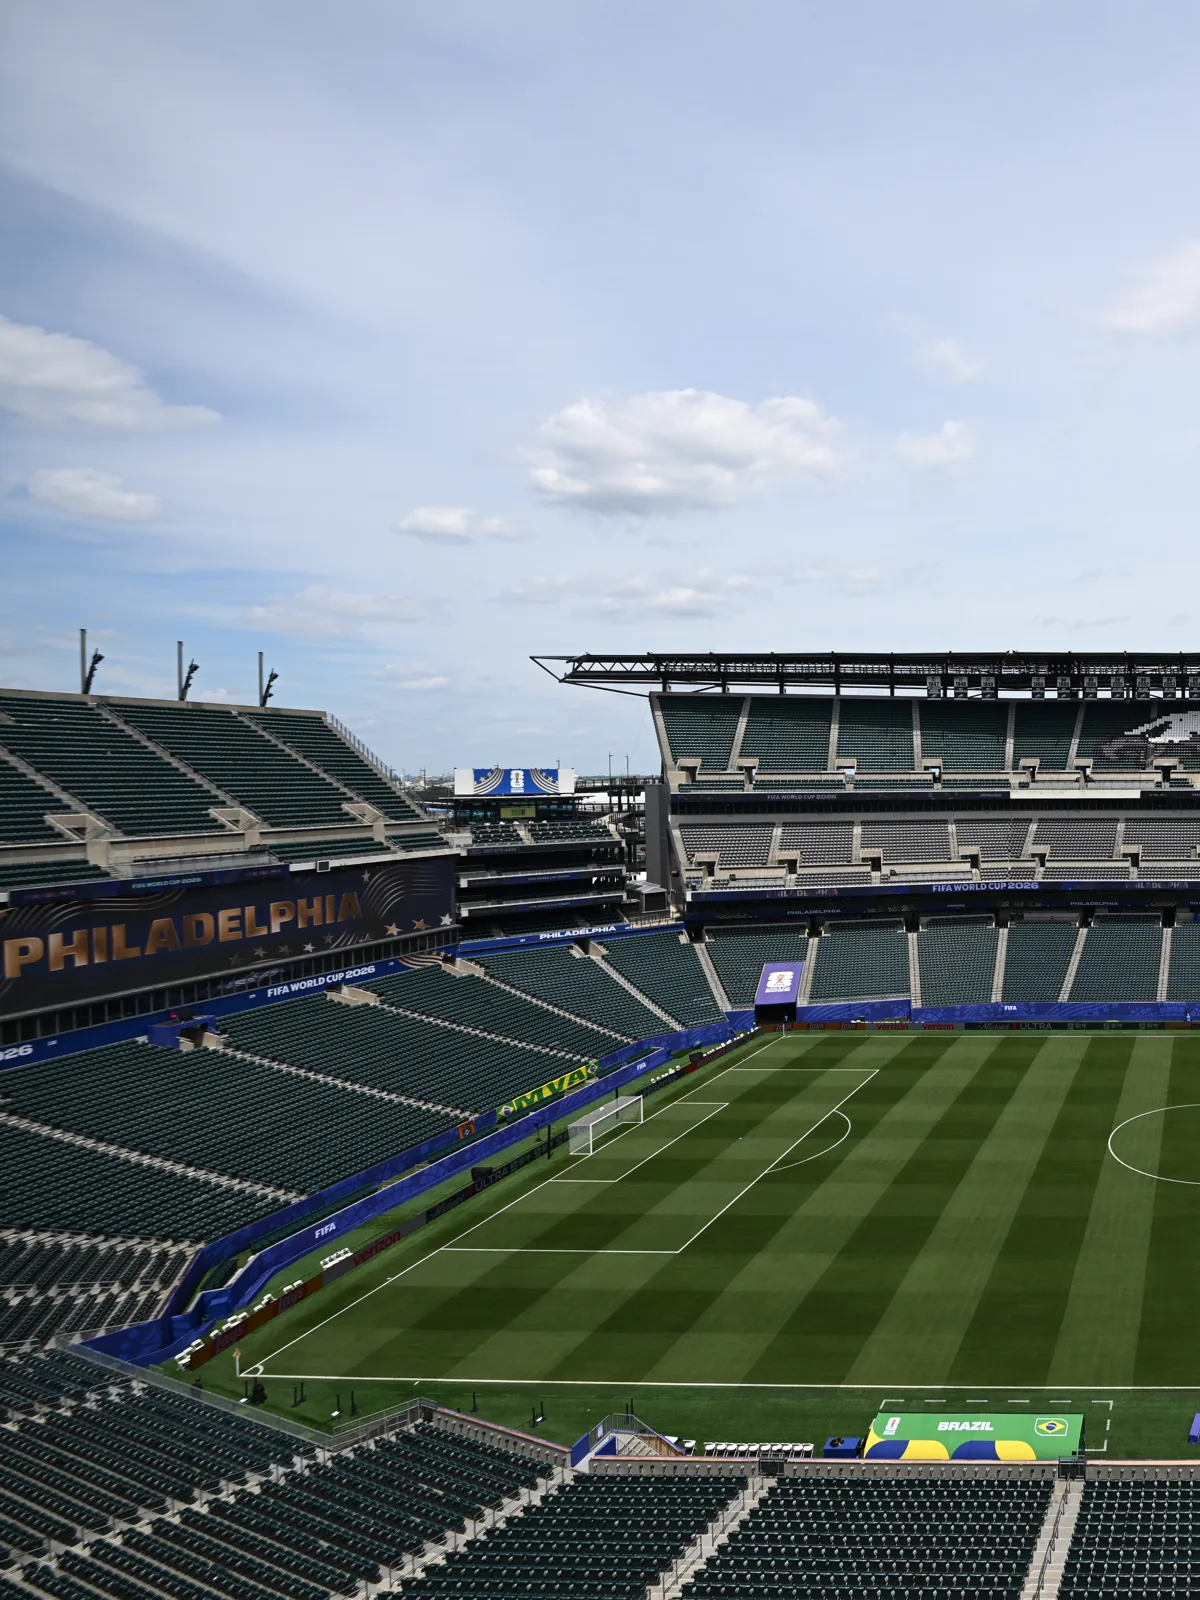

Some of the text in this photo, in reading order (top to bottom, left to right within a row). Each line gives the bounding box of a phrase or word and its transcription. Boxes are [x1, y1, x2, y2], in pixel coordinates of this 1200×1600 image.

[147, 880, 169, 888] WORLD
[933, 884, 953, 892] FIFA
[954, 883, 988, 892] WORLD
[4, 891, 363, 979] PHILADELPHIA
[539, 925, 617, 940] PHILADELPHIA
[267, 966, 376, 998] FIFA WORLD CUP 2026
[1019, 1022, 1053, 1030] ULTRA
[636, 1061, 647, 1071] FIFA
[474, 1168, 509, 1193] ULTRA
[314, 1222, 337, 1239] FIFA
[353, 1231, 401, 1266] verizon
[937, 1421, 994, 1431] BRAZIL
